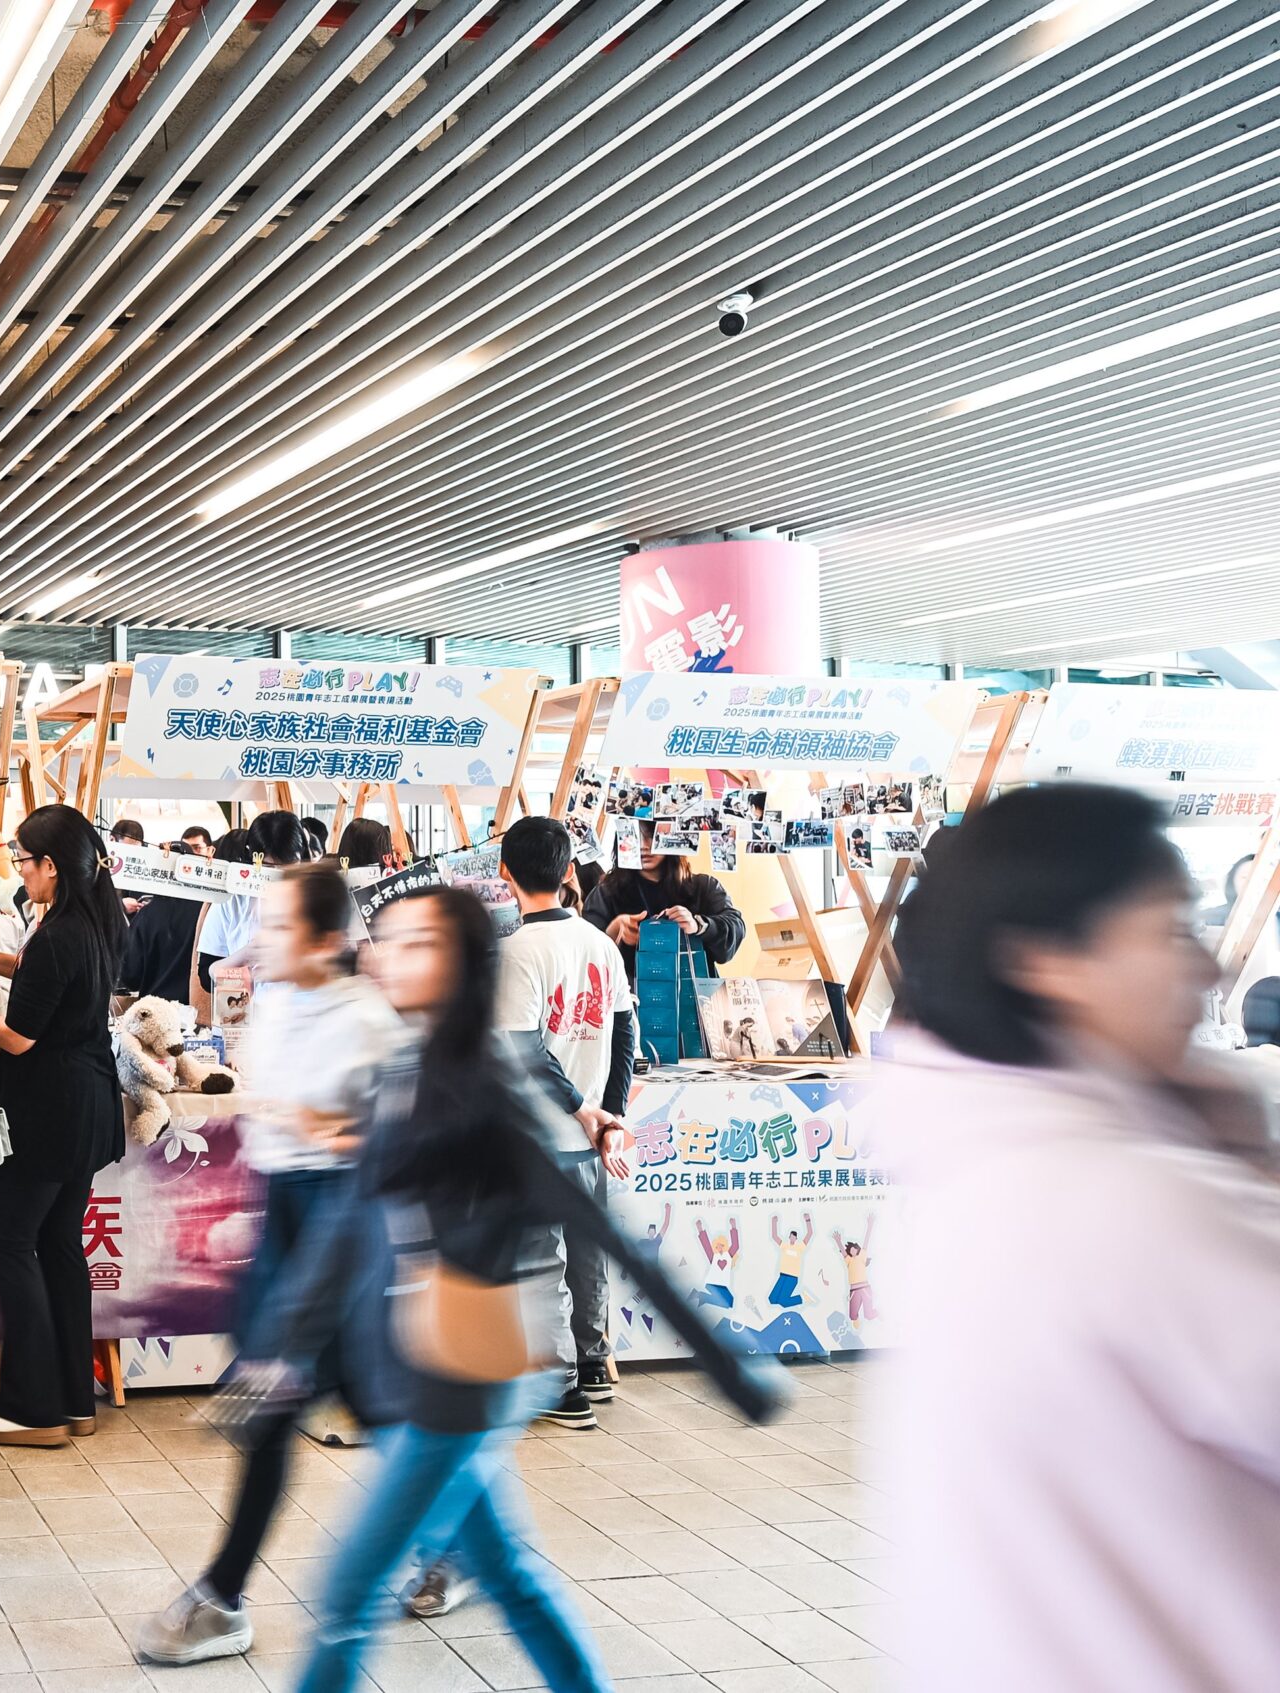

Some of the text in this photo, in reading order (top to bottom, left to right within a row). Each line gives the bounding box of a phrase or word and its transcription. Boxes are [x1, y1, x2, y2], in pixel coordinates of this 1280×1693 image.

[644, 603, 745, 673] 電影
[258, 668, 421, 693] 志在必行 PLAY!
[728, 686, 873, 709] 志在必行 PLAY!
[164, 709, 487, 747] 天使心家族社會福利基金會
[665, 726, 900, 761] 桃園生命樹領袖協會
[240, 747, 403, 780] 桃園分事務所
[1173, 793, 1276, 816] 問答挑戰賽
[633, 1113, 798, 1168] 志在必行
